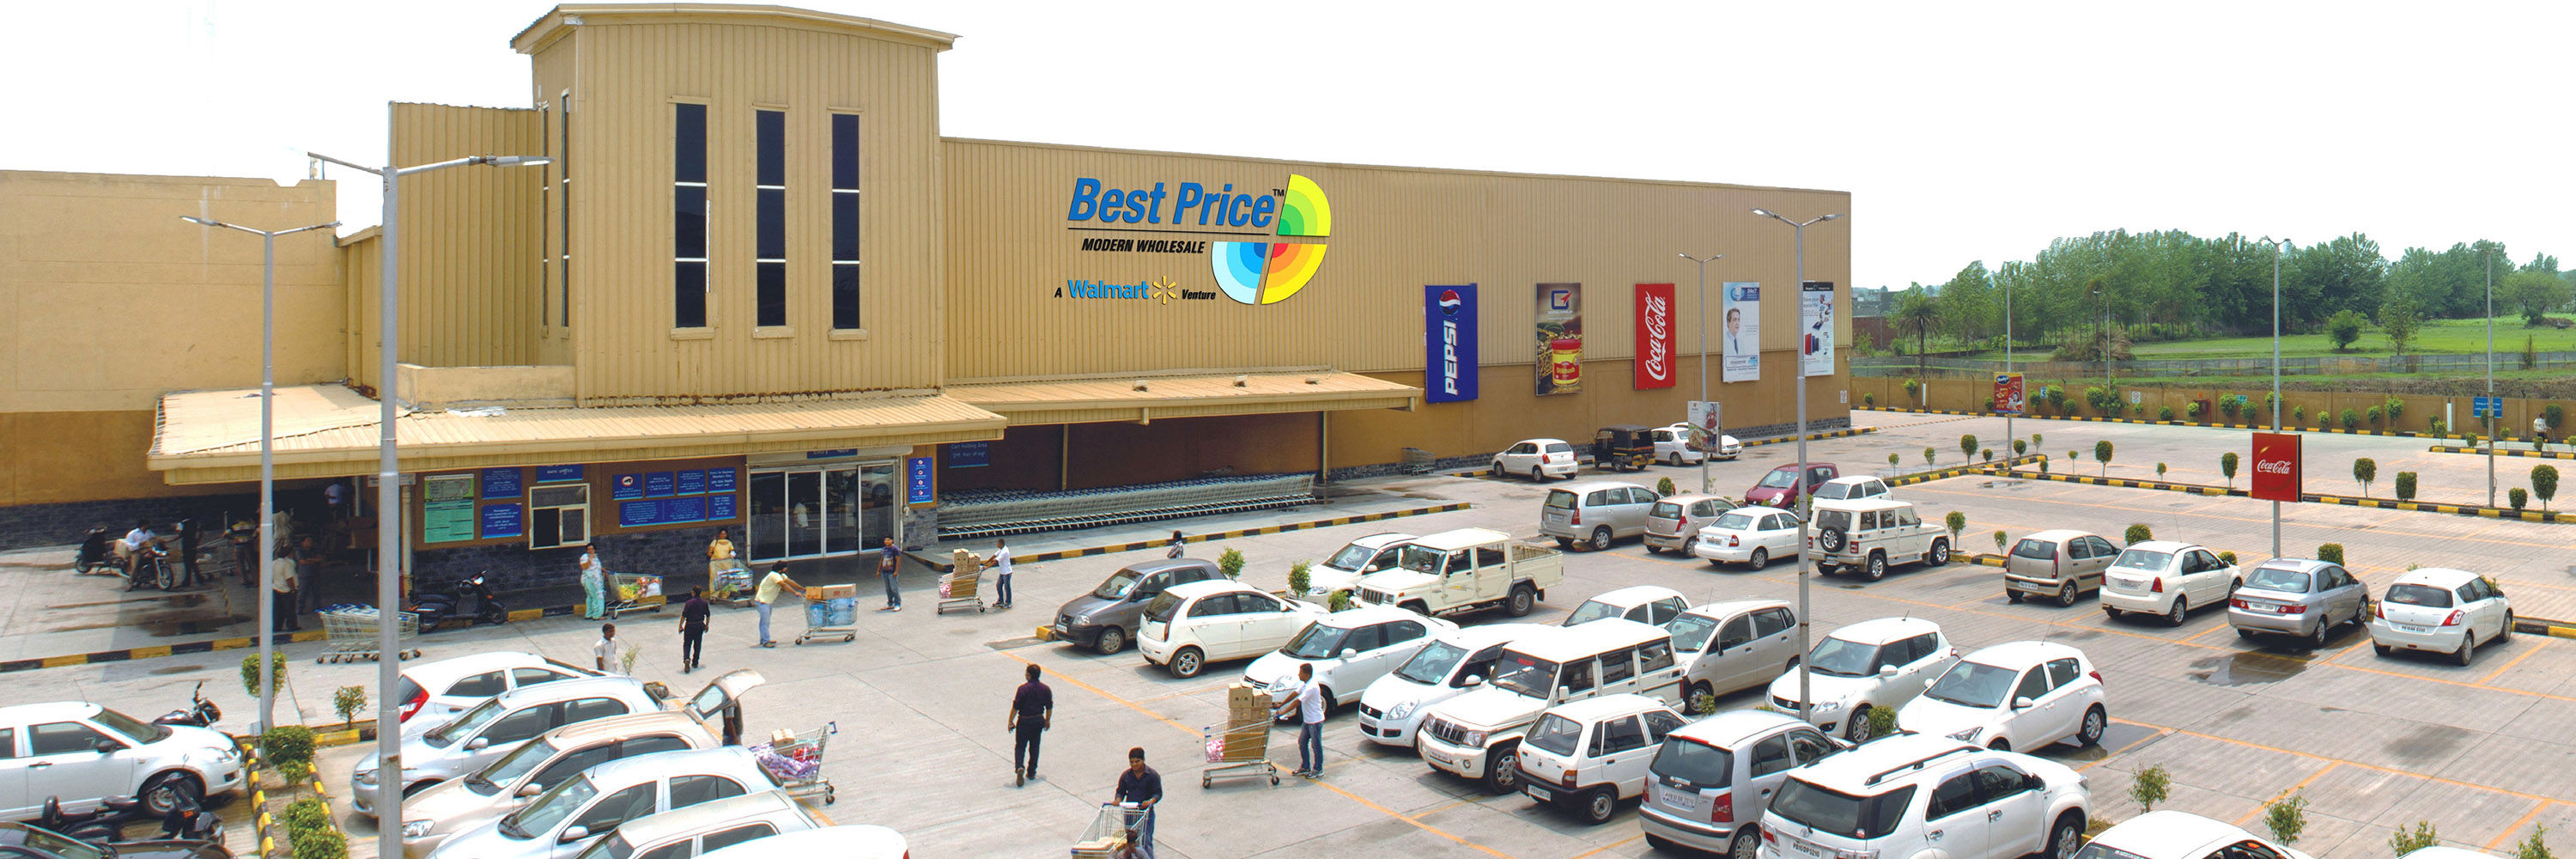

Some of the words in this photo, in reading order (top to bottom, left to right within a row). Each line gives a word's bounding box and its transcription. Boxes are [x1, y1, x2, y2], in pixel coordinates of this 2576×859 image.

[1067, 177, 1165, 224] Best
[1172, 182, 1276, 228] Price
[1081, 238, 1134, 253] MODERN
[1136, 240, 1206, 254] WHOLESALE
[1054, 287, 1063, 298] A
[1067, 279, 1149, 299] Walmart
[1182, 289, 1217, 301] Venture
[1645, 290, 1667, 381] Coca-Cola
[1443, 320, 1458, 396] PEPSI
[2257, 459, 2293, 474] Coca-Cola
